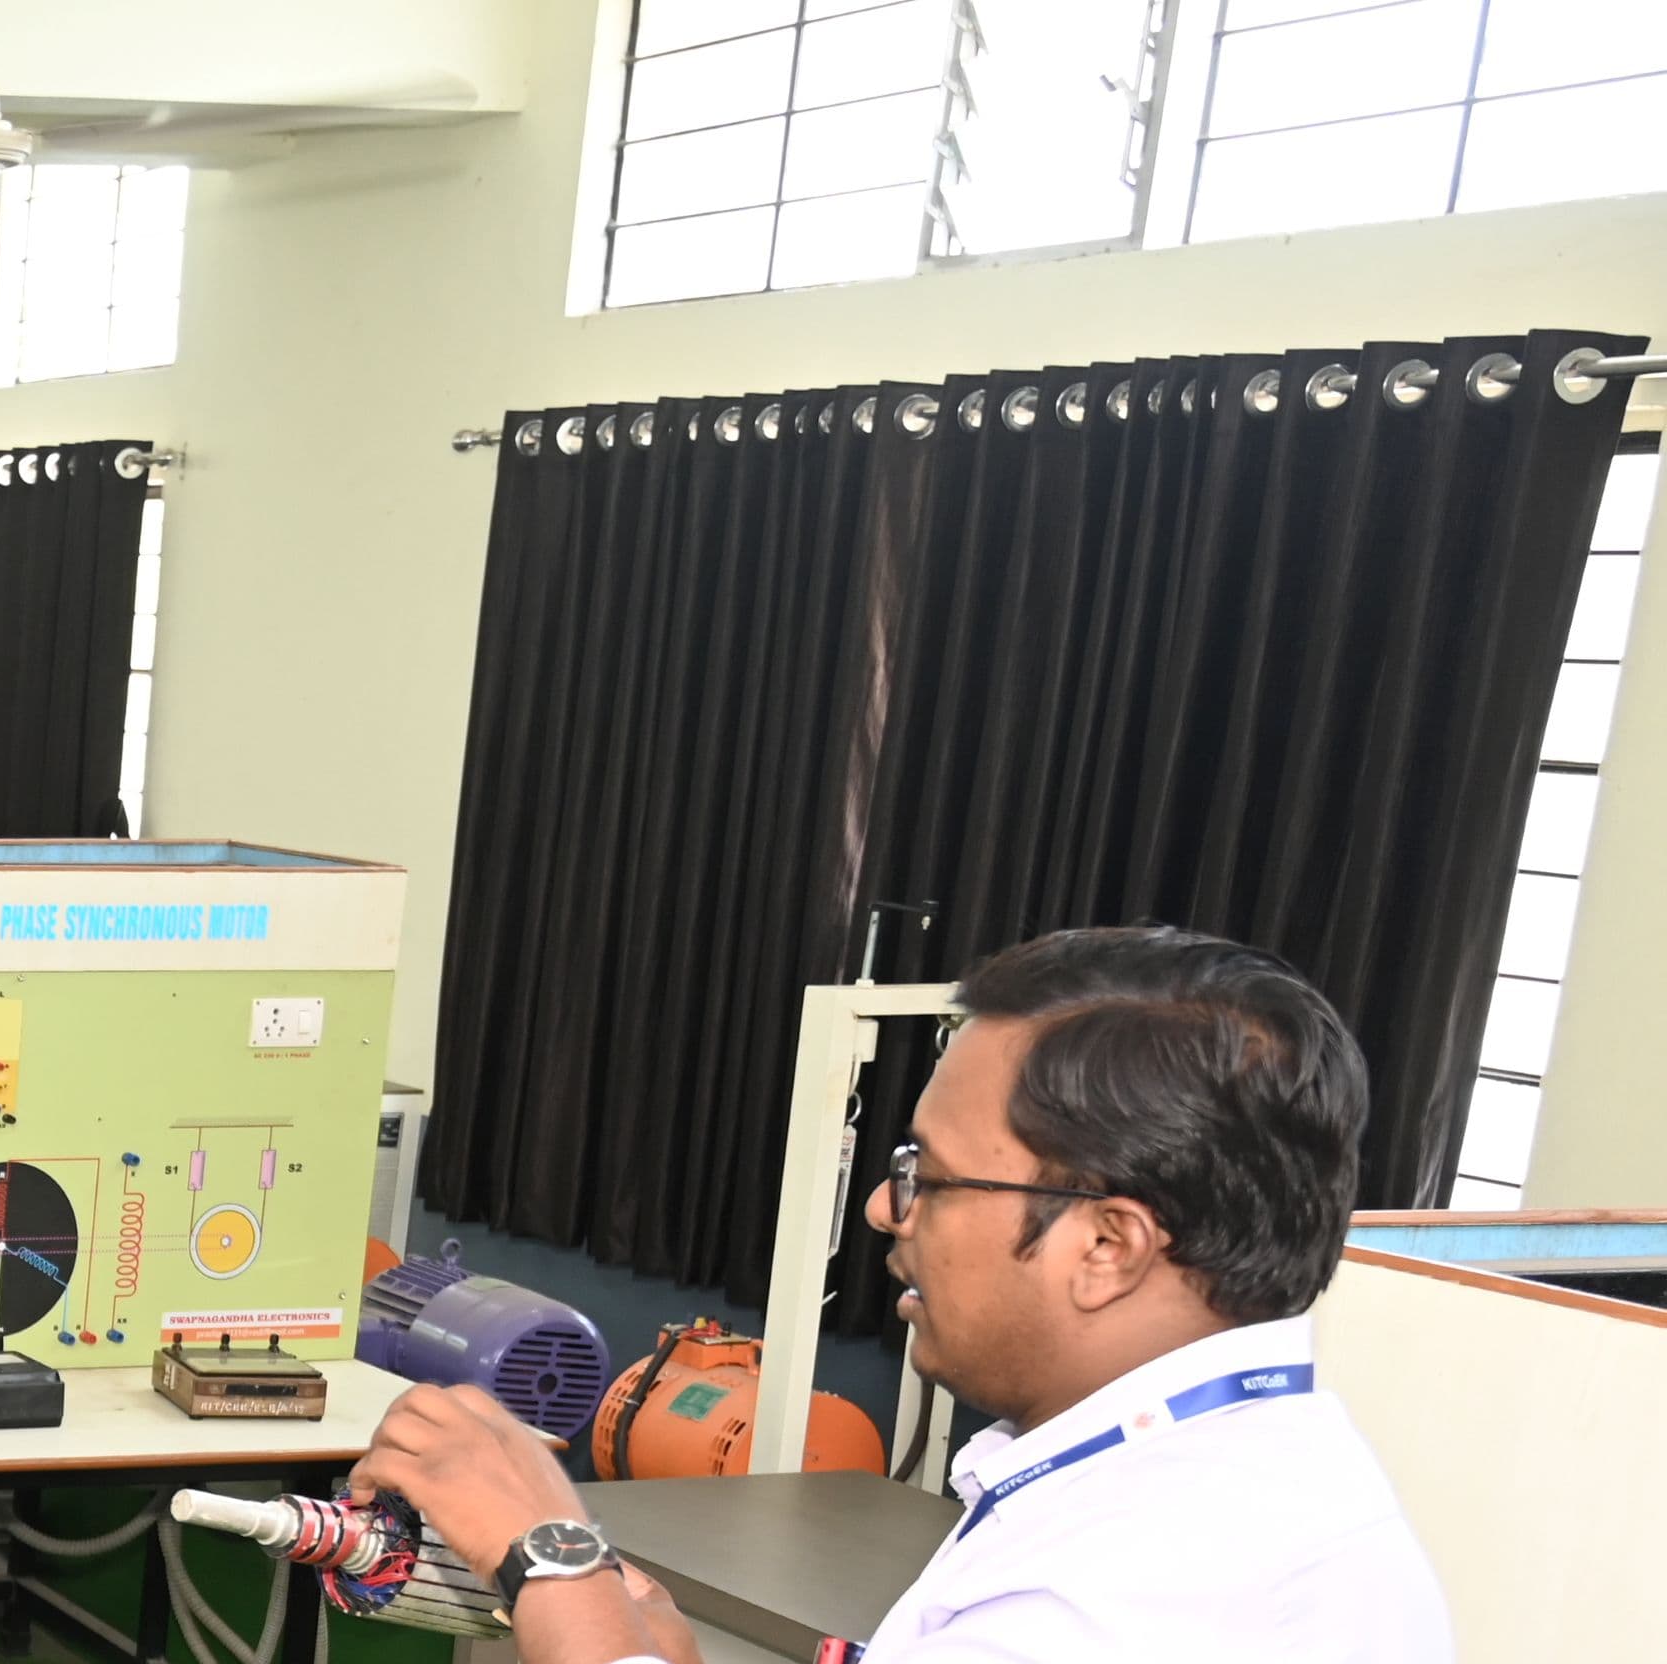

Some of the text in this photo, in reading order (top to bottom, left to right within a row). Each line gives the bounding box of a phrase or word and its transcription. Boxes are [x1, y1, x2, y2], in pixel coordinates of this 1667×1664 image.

[0, 904, 57, 940] PHASE
[64, 904, 204, 940] SYNCHRONOUS
[207, 904, 269, 940] MOTOR
[164, 1166, 178, 1174] S1
[288, 1163, 302, 1173] S2
[170, 1312, 331, 1325] SWAPNAGANDHA ELECTRONICS
[1241, 1372, 1288, 1392] KITCoEK
[994, 1460, 1054, 1498] KITCoEK
